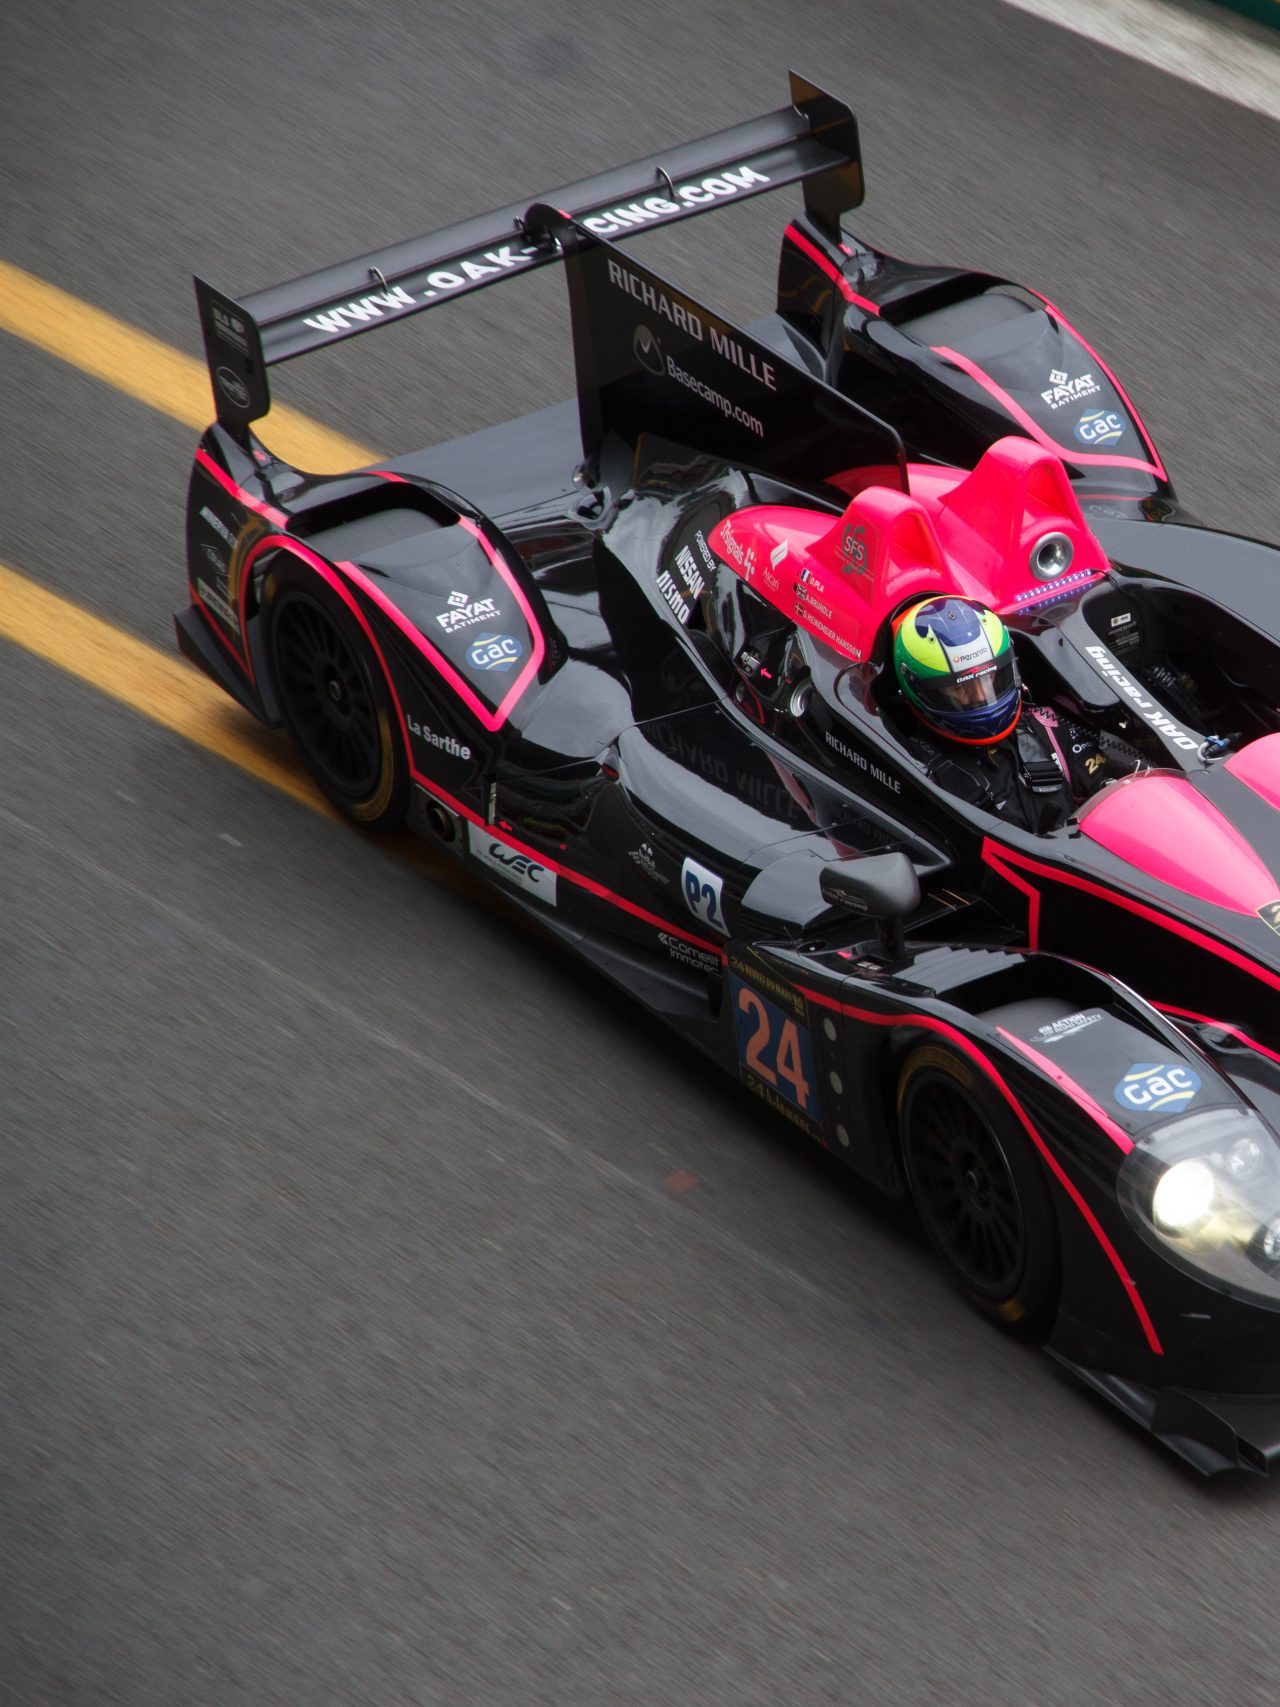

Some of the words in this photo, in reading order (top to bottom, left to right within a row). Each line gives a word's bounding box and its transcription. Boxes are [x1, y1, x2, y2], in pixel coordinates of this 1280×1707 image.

[608, 259, 703, 341] RICHARD
[709, 326, 777, 391] MILLE
[667, 354, 764, 437] Basecamp.com
[1041, 373, 1095, 404] FAYAT
[1050, 385, 1101, 410] BATIMENT
[694, 530, 711, 563] POWERED
[706, 559, 717, 572] BY
[844, 536, 865, 561] SFS
[675, 544, 705, 600] NISSAN
[436, 598, 496, 628] FAYAT
[445, 610, 502, 634] BATIMENT
[1085, 645, 1153, 709] racing
[406, 714, 421, 736] La
[423, 725, 471, 760] Sarthe
[1144, 710, 1198, 750] OAK
[825, 731, 867, 771] RICHARD
[870, 763, 900, 794] MILLE
[489, 843, 544, 883] WEC
[685, 869, 724, 928] P2
[739, 987, 809, 1109] 24
